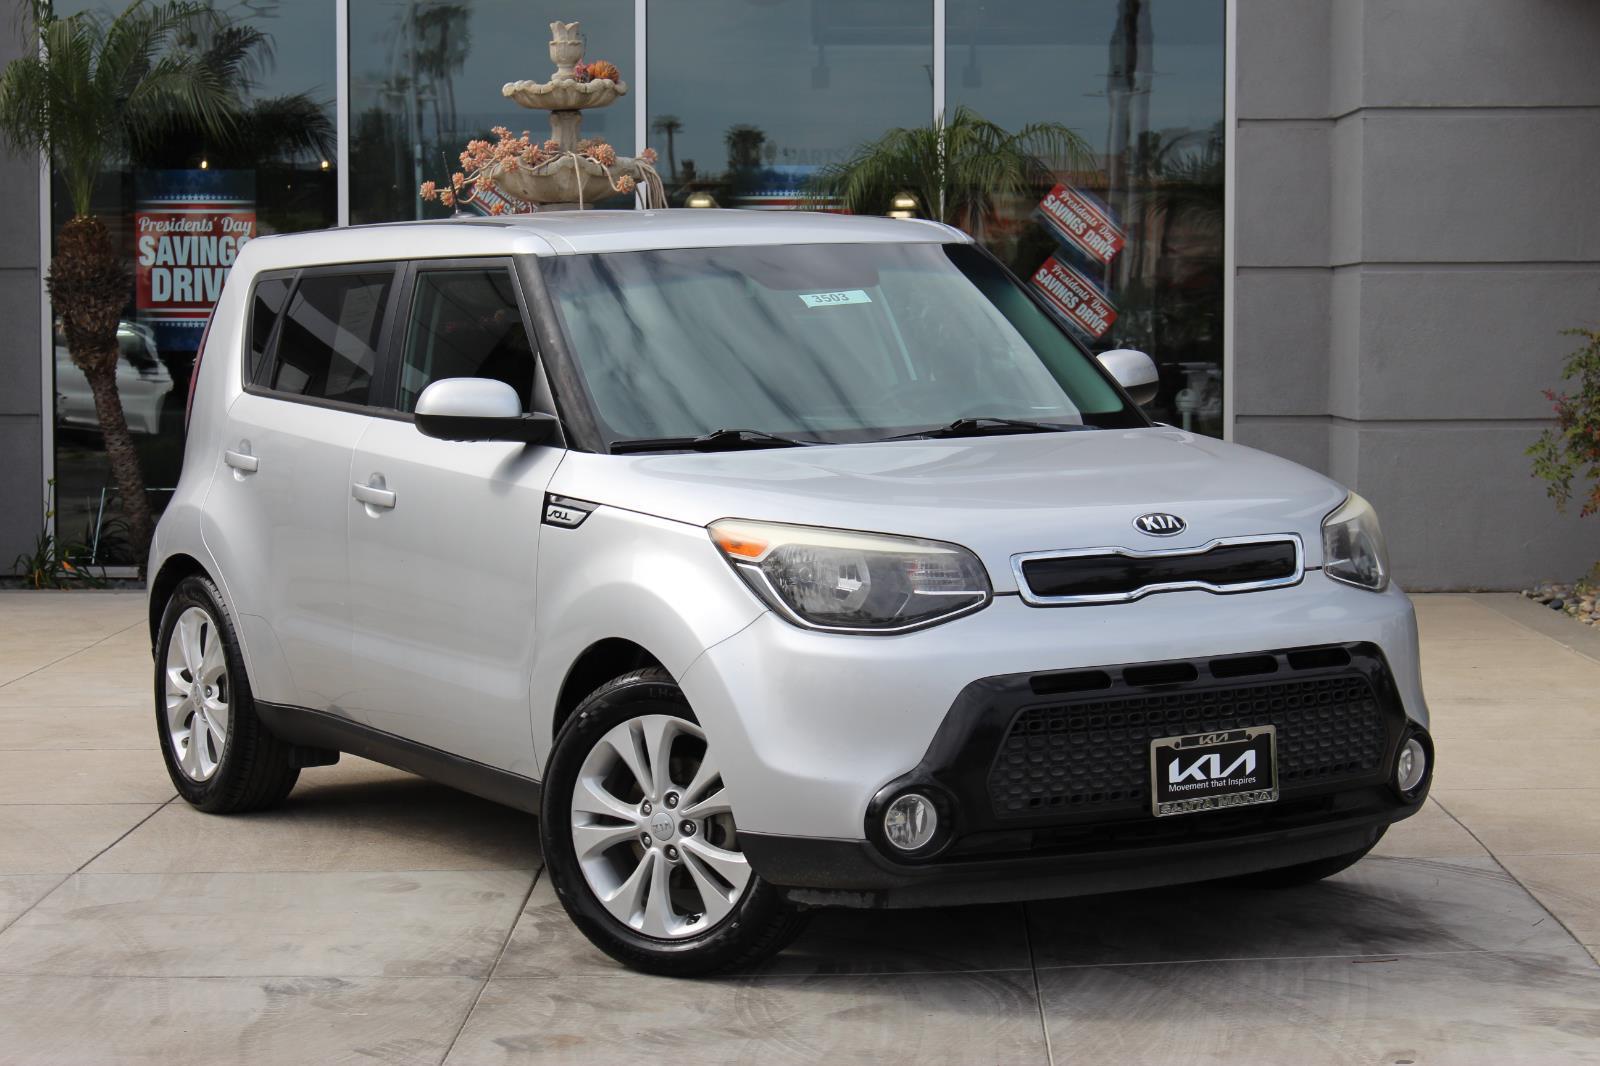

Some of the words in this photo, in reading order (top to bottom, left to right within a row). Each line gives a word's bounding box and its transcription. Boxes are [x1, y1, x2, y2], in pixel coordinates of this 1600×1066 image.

[138, 216, 217, 232] Presidents'
[221, 216, 252, 235] Day
[1043, 194, 1087, 235] SAVINGS
[1084, 231, 1116, 260] DRIVE
[1098, 223, 1116, 243] Day
[151, 267, 230, 302] DRIV
[811, 293, 850, 303] 3503
[1035, 268, 1079, 309] SAVINGS
[1076, 305, 1108, 334] DRIVE
[1091, 297, 1108, 317] Day
[1140, 515, 1182, 531] KIA
[1199, 732, 1229, 745] KIA
[1168, 749, 1256, 784] KIA
[1168, 781, 1209, 793] Movement
[1211, 779, 1227, 788] that
[1228, 775, 1256, 787] Inspires
